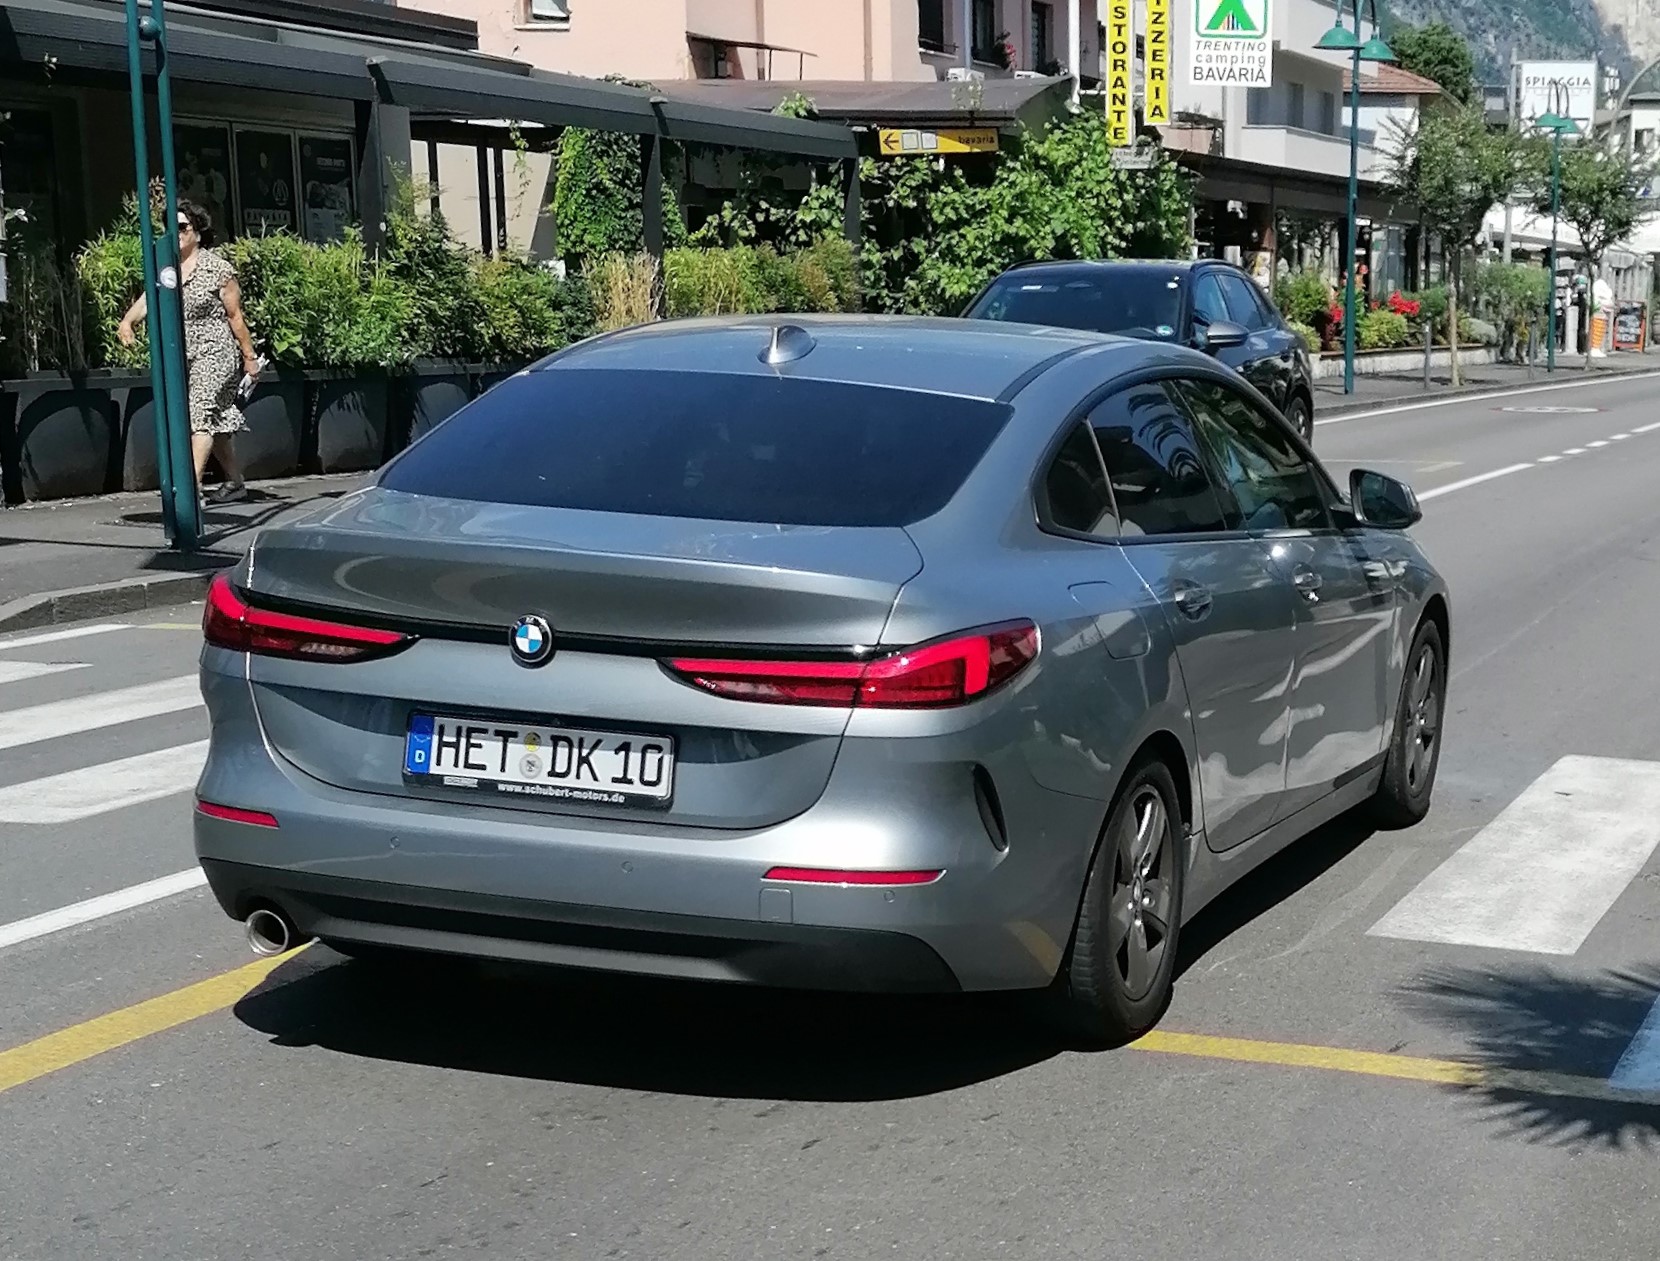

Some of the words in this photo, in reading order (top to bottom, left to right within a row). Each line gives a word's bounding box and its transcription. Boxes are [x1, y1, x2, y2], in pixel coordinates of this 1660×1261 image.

[1195, 40, 1267, 52] TRENTINO
[1195, 53, 1266, 67] camping
[1112, 0, 1127, 140] STORANTE
[1193, 66, 1267, 82] BAVARIA
[1525, 76, 1591, 86] SPIAGGIA
[414, 750, 425, 763] D
[436, 723, 518, 773] HET
[547, 734, 604, 782] DK
[611, 741, 664, 787] 10
[497, 783, 625, 803] www.schubert-motors.de
